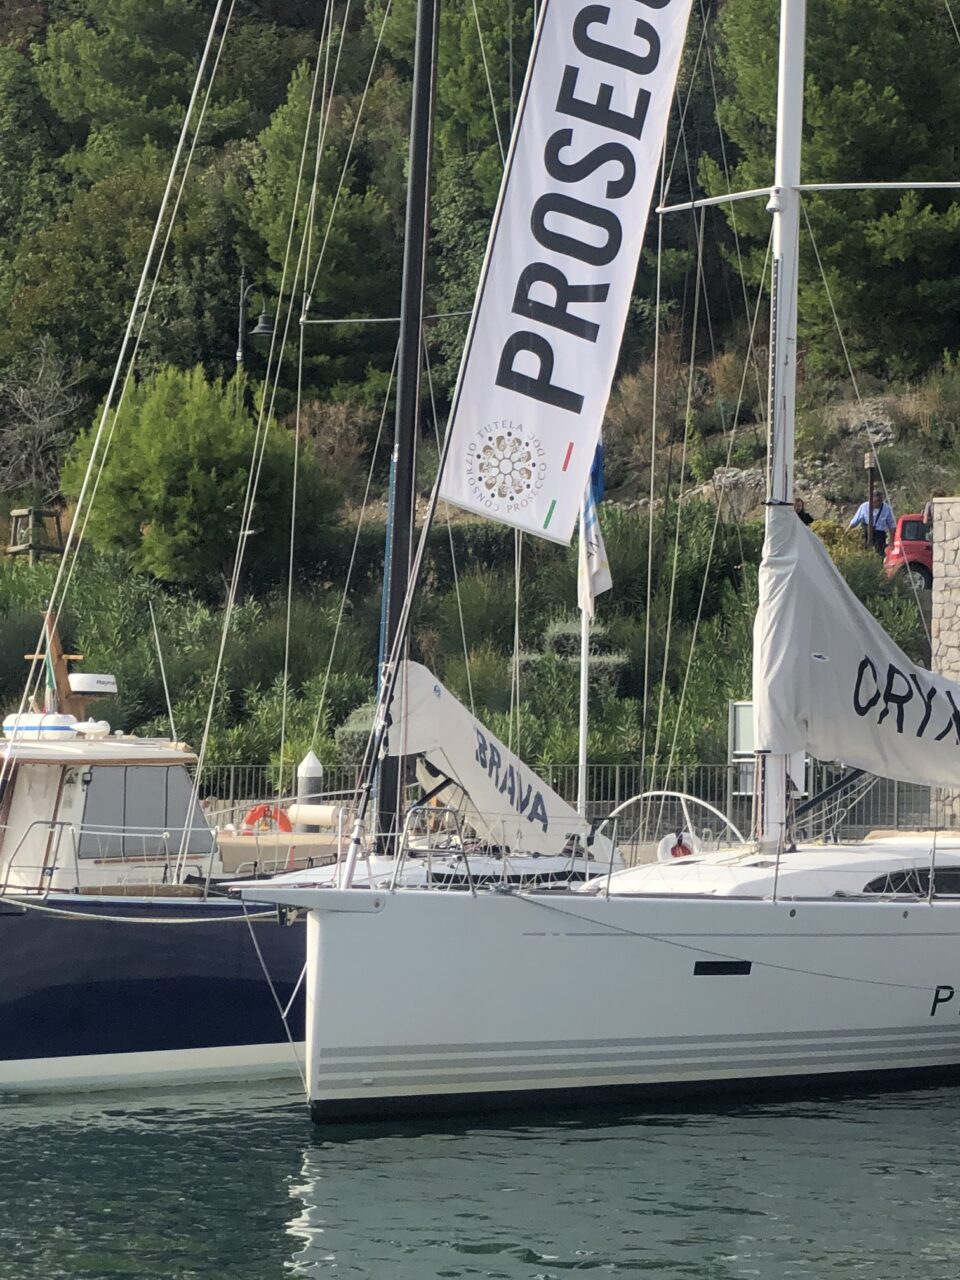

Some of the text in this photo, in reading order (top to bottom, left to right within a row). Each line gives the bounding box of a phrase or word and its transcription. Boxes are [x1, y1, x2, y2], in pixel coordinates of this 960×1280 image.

[465, 420, 523, 512] CONSORZIO TUTELA
[506, 432, 547, 514] PROSECCO DOC
[474, 724, 549, 834] BRAVA
